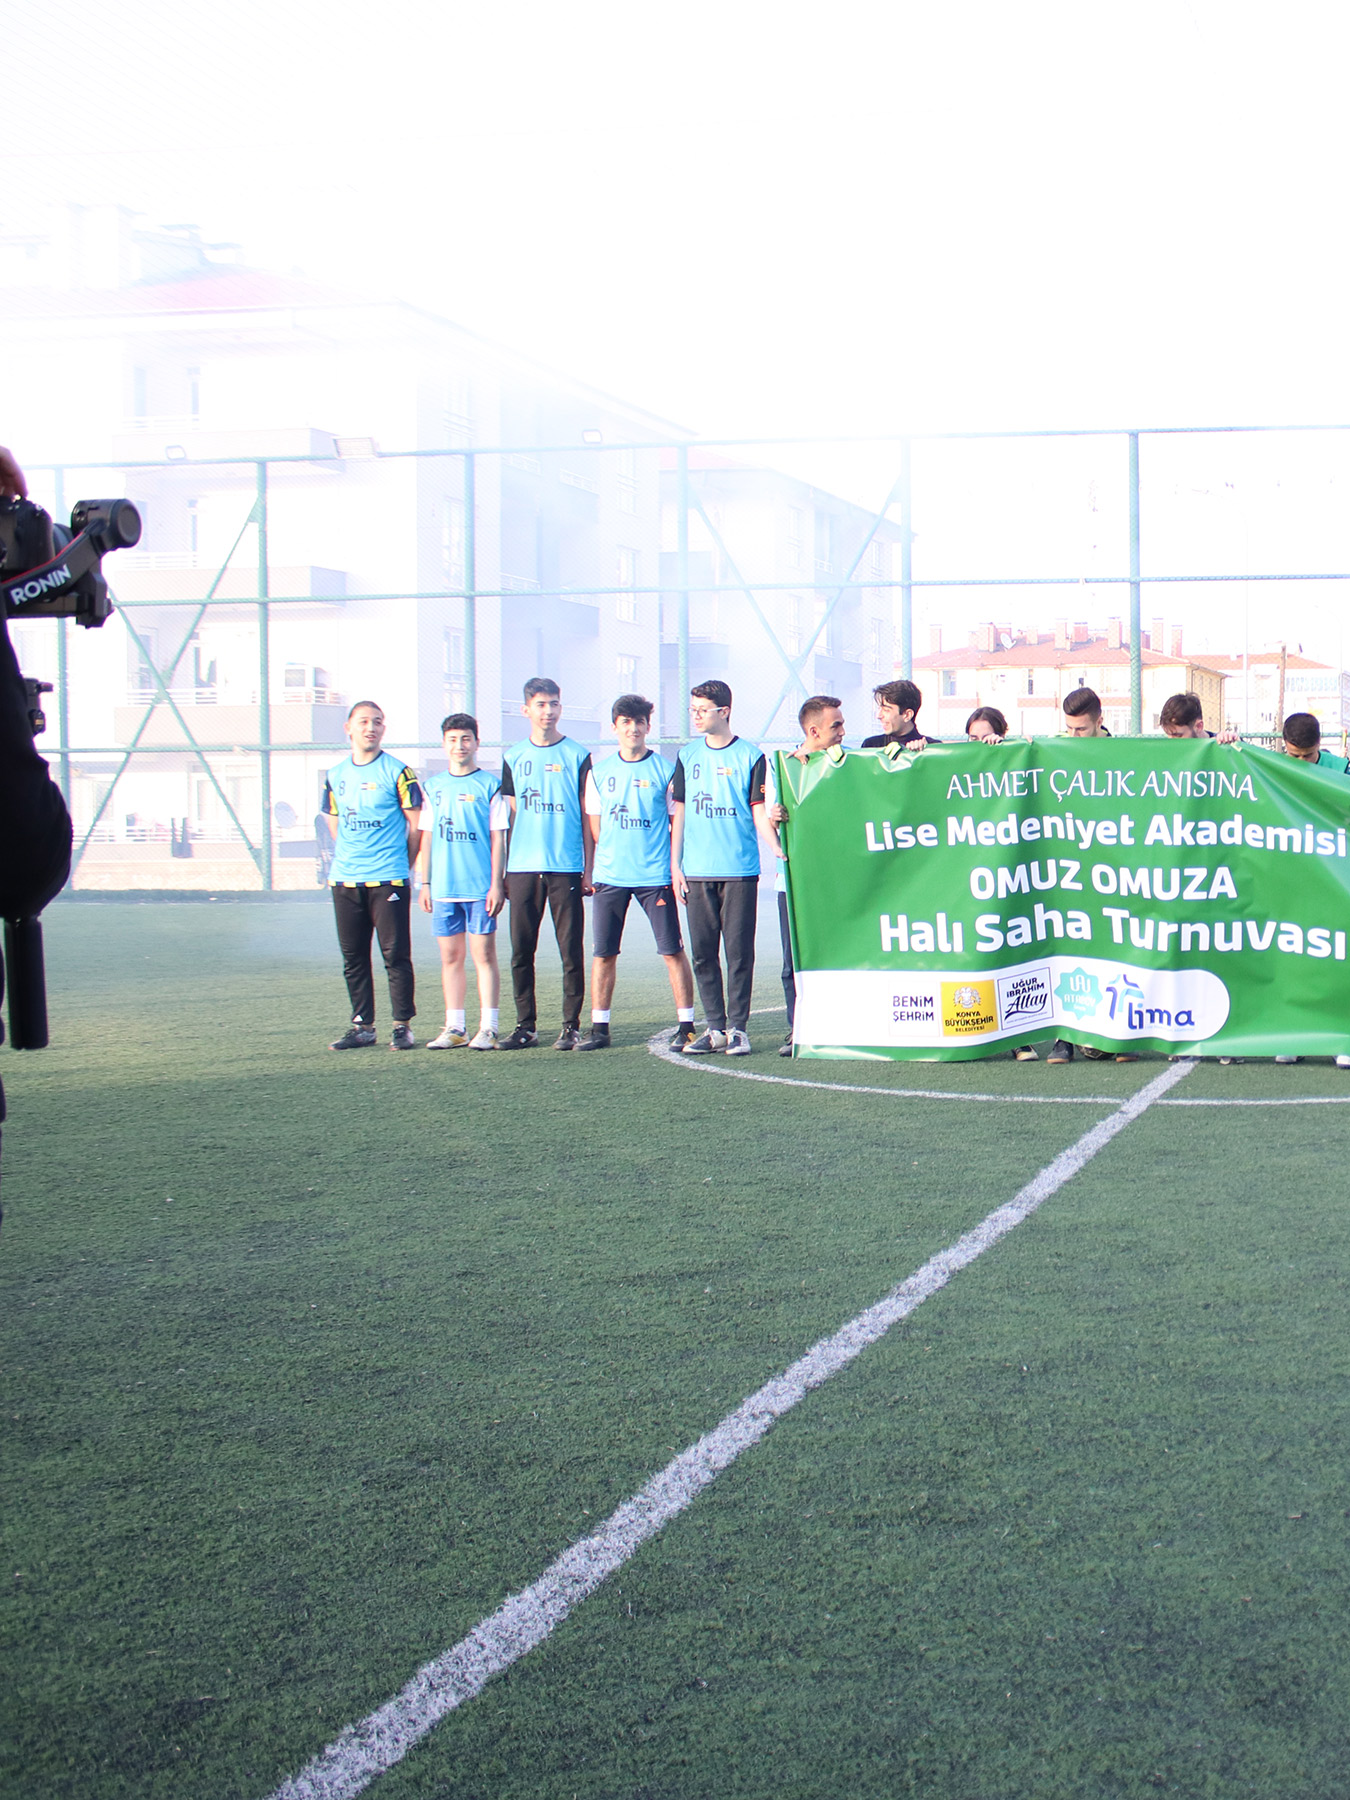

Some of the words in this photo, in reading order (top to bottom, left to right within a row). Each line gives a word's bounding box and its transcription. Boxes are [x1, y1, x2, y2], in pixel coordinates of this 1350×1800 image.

[10, 563, 72, 606] RONIN
[519, 760, 532, 778] 10
[693, 763, 701, 780] 6
[338, 780, 346, 796] 8
[607, 776, 616, 793] 9
[946, 768, 1045, 800] AHMET
[1049, 769, 1136, 803] ÇALIK
[1140, 770, 1258, 802] ANISINA
[435, 791, 442, 807] 5
[865, 821, 939, 852] Lise
[946, 811, 1135, 850] Medeniyet
[1143, 813, 1347, 858] Akademisi
[969, 858, 1083, 900] OMUZ
[1091, 863, 1238, 901] OMUZA
[879, 912, 964, 954] Halı
[974, 903, 1092, 953] Saha
[1102, 906, 1346, 961] Turnuvası
[1011, 977, 1038, 990] UĞUR
[1004, 992, 1049, 1018] Altay
[944, 1015, 994, 1027] BÜYÜKŞEHİR
